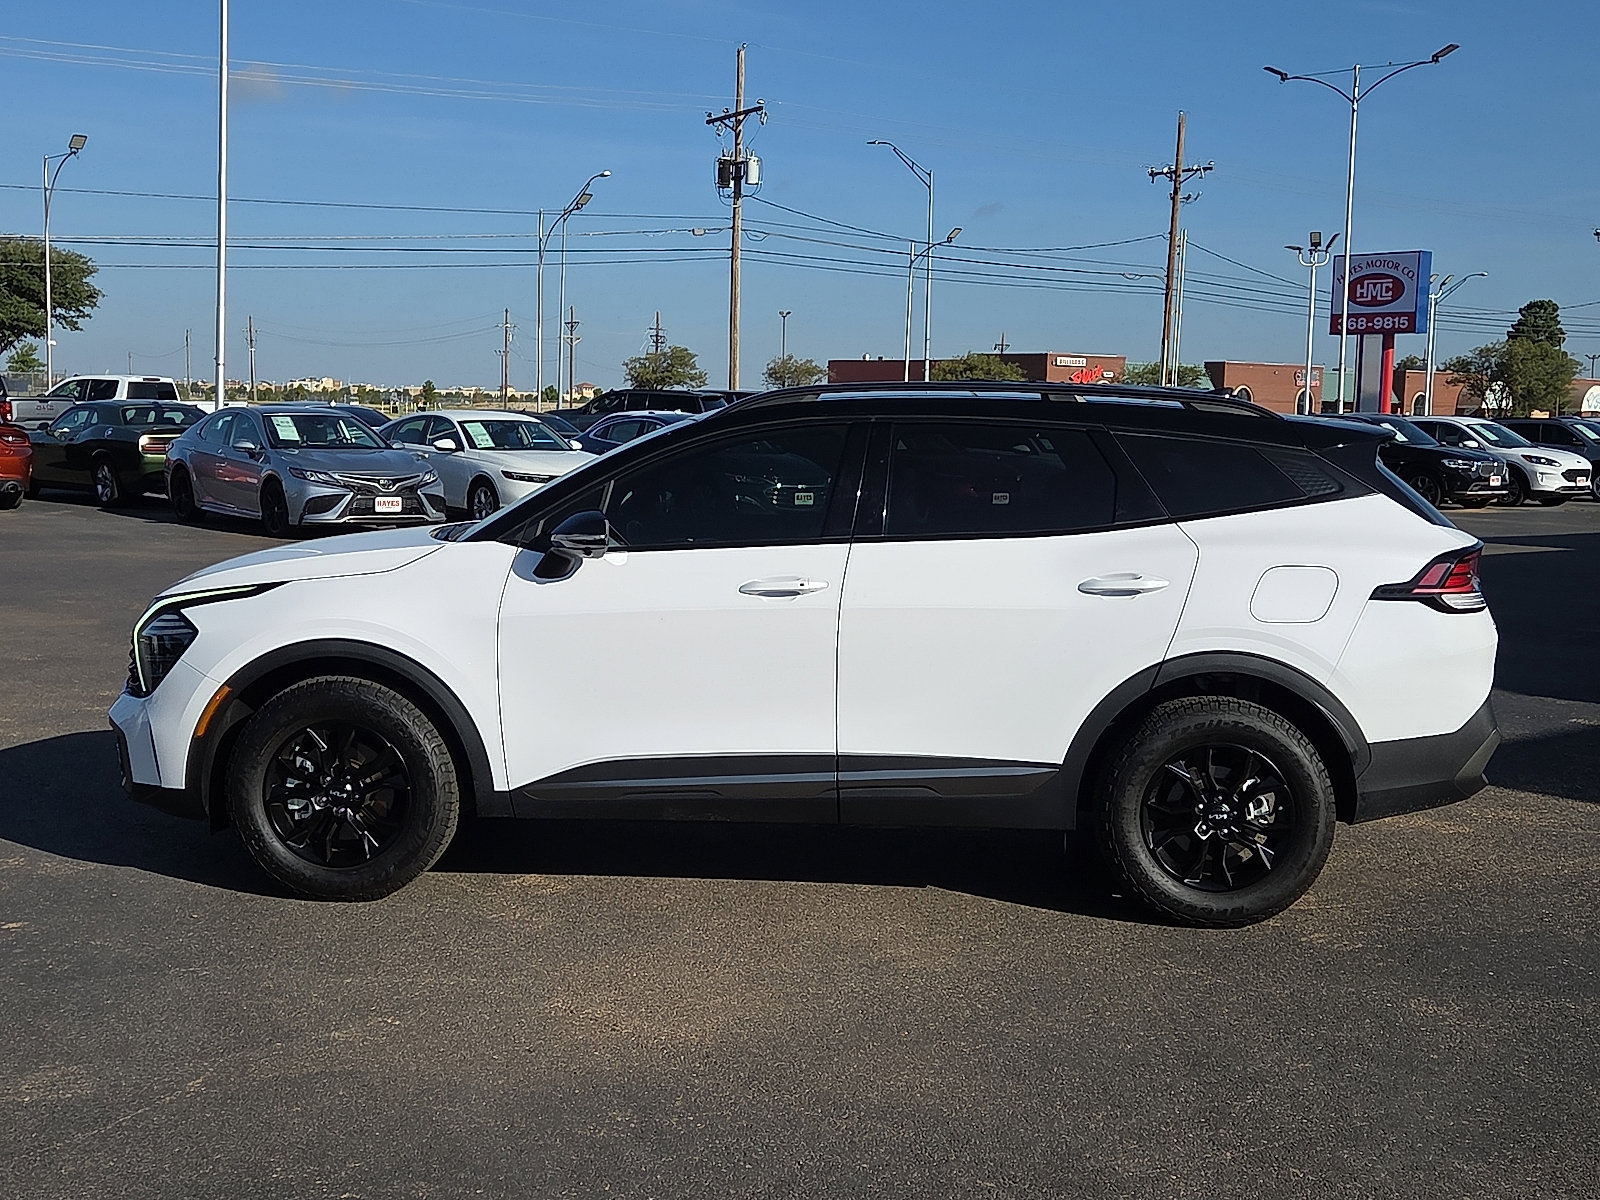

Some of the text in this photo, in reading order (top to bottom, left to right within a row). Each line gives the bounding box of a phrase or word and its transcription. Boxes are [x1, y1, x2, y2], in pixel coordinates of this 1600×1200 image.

[1336, 259, 1415, 285] HYES MOTOR CO.
[1356, 279, 1393, 301] HMC
